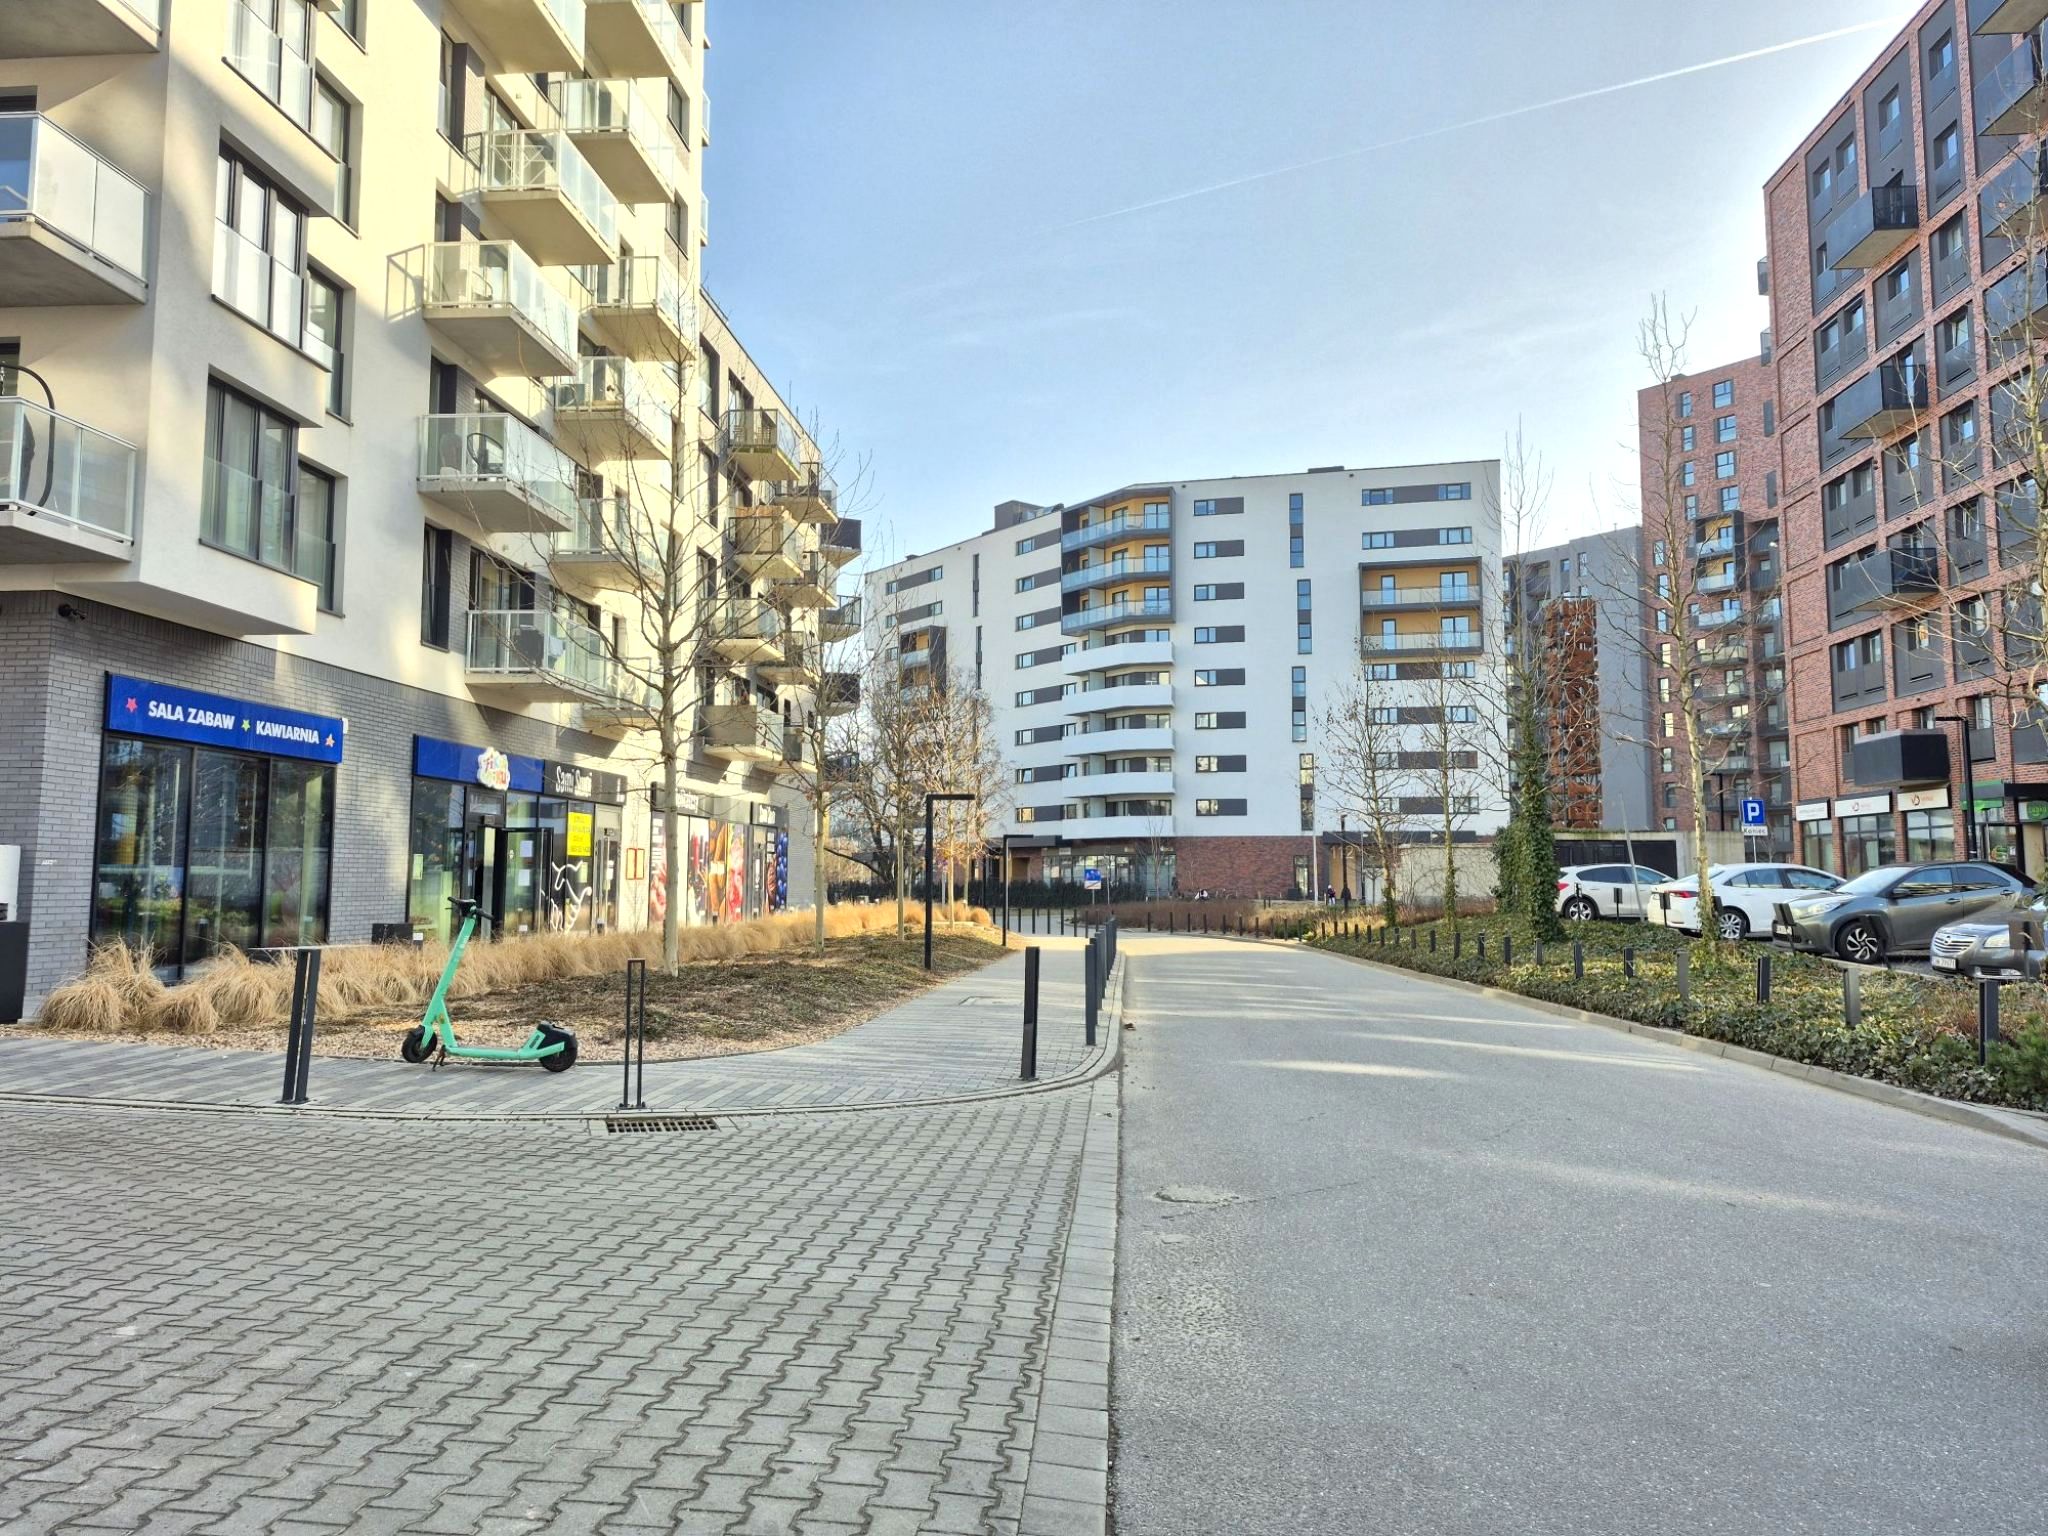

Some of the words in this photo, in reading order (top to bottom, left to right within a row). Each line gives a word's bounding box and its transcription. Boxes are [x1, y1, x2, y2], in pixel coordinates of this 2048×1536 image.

[148, 700, 184, 722] SALA
[186, 707, 235, 730] ZABAW
[256, 720, 320, 744] KAWIARNIA
[1746, 802, 1760, 822] P
